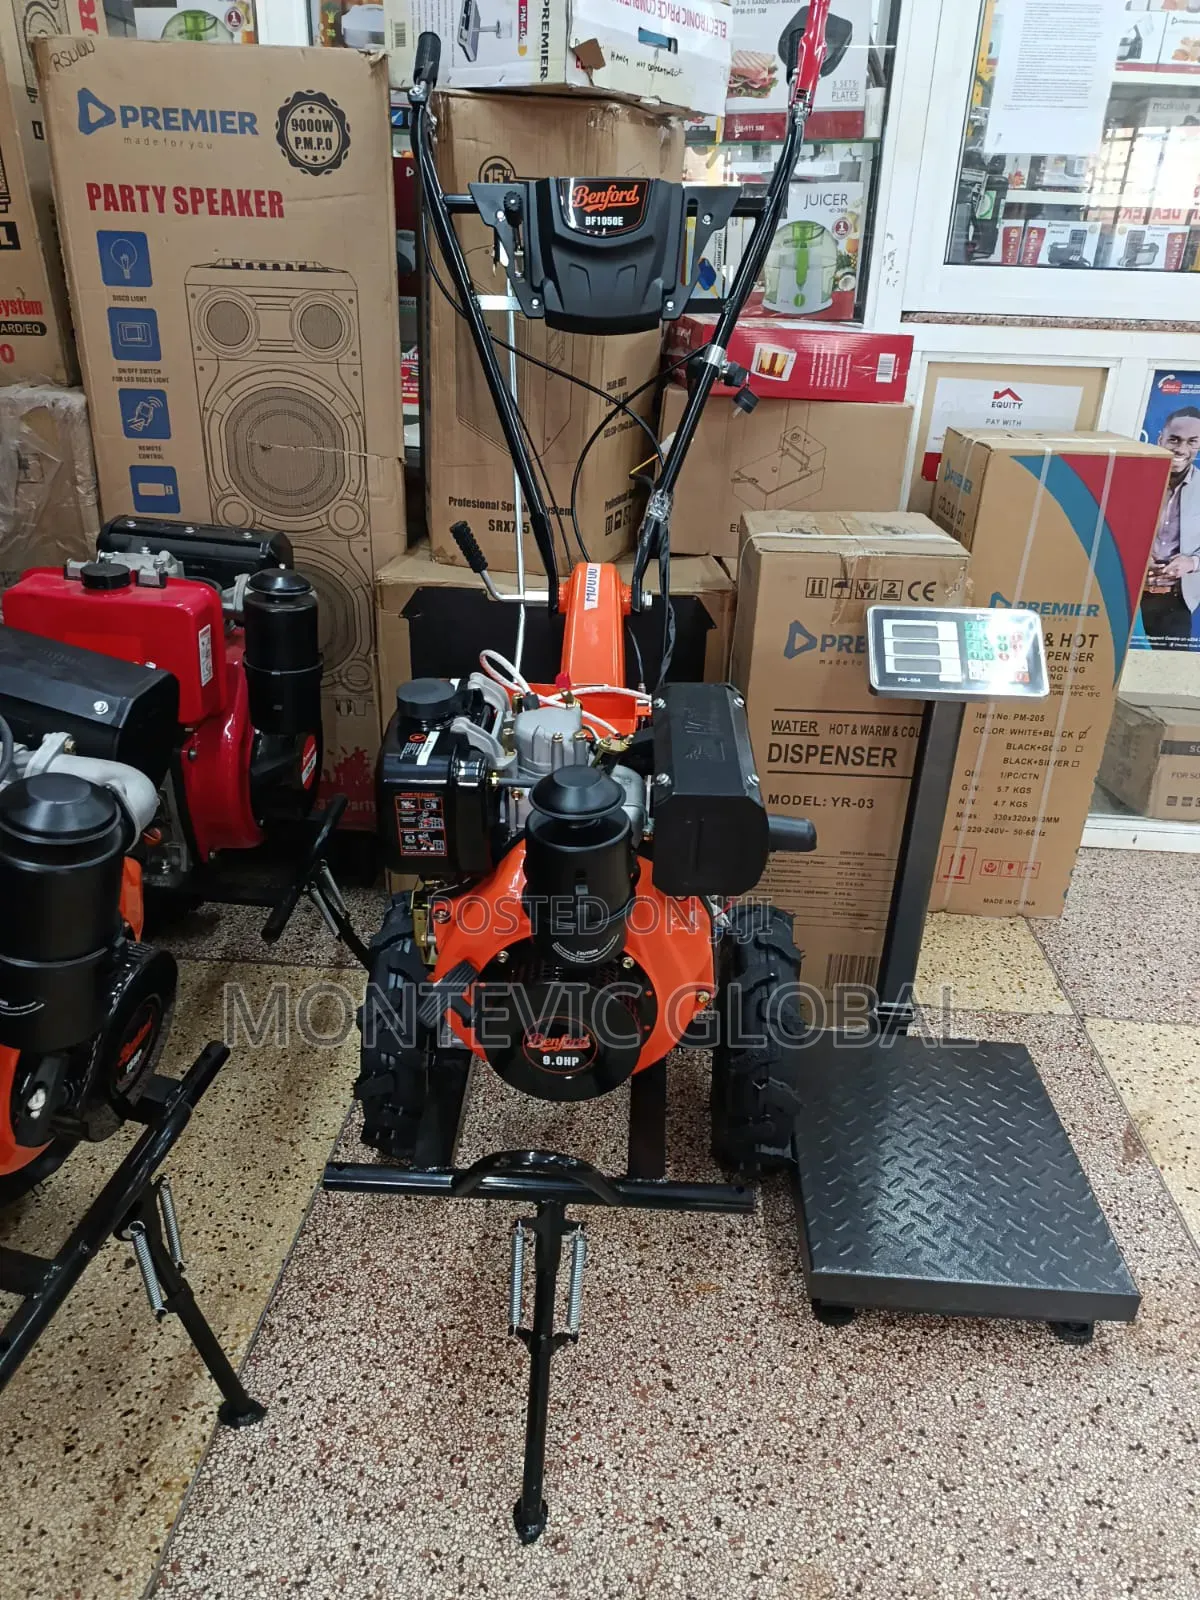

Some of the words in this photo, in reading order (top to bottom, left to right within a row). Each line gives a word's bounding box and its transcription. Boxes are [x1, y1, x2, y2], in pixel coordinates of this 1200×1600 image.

[518, 5, 528, 41] PM-40
[119, 104, 260, 136] PREMIER
[291, 118, 334, 134] 9000W
[123, 136, 160, 148] made
[294, 136, 333, 152] P.M.P.O
[86, 183, 167, 213] PARTY
[173, 186, 285, 218] SPEAKER
[571, 183, 641, 214] Benford
[803, 193, 849, 209] JUICER
[585, 216, 624, 227] BF1050E
[991, 401, 1024, 410] EQUITY
[1002, 419, 1022, 427] WITH
[448, 495, 500, 511] Profesional
[488, 519, 530, 535] SRX75
[1059, 632, 1100, 649] HOT
[1046, 651, 1095, 662] PENSER
[1047, 665, 1086, 674] OOLNG
[1013, 713, 1045, 722] PM-205
[771, 720, 819, 733] WATER
[829, 723, 849, 736] HOT
[851, 724, 857, 735] &
[860, 725, 890, 737] WARM
[892, 726, 898, 737] &
[901, 726, 921, 738] COL
[1010, 728, 1074, 739] WHITE+BLCK
[767, 742, 898, 768] DISPENSER
[1013, 786, 1032, 794] KGS
[768, 793, 827, 807] MODEL:
[831, 796, 875, 809] YR-03
[1009, 800, 1028, 808] KGS
[527, 1032, 591, 1053] Benford
[542, 1055, 580, 1067] 9.0HP
